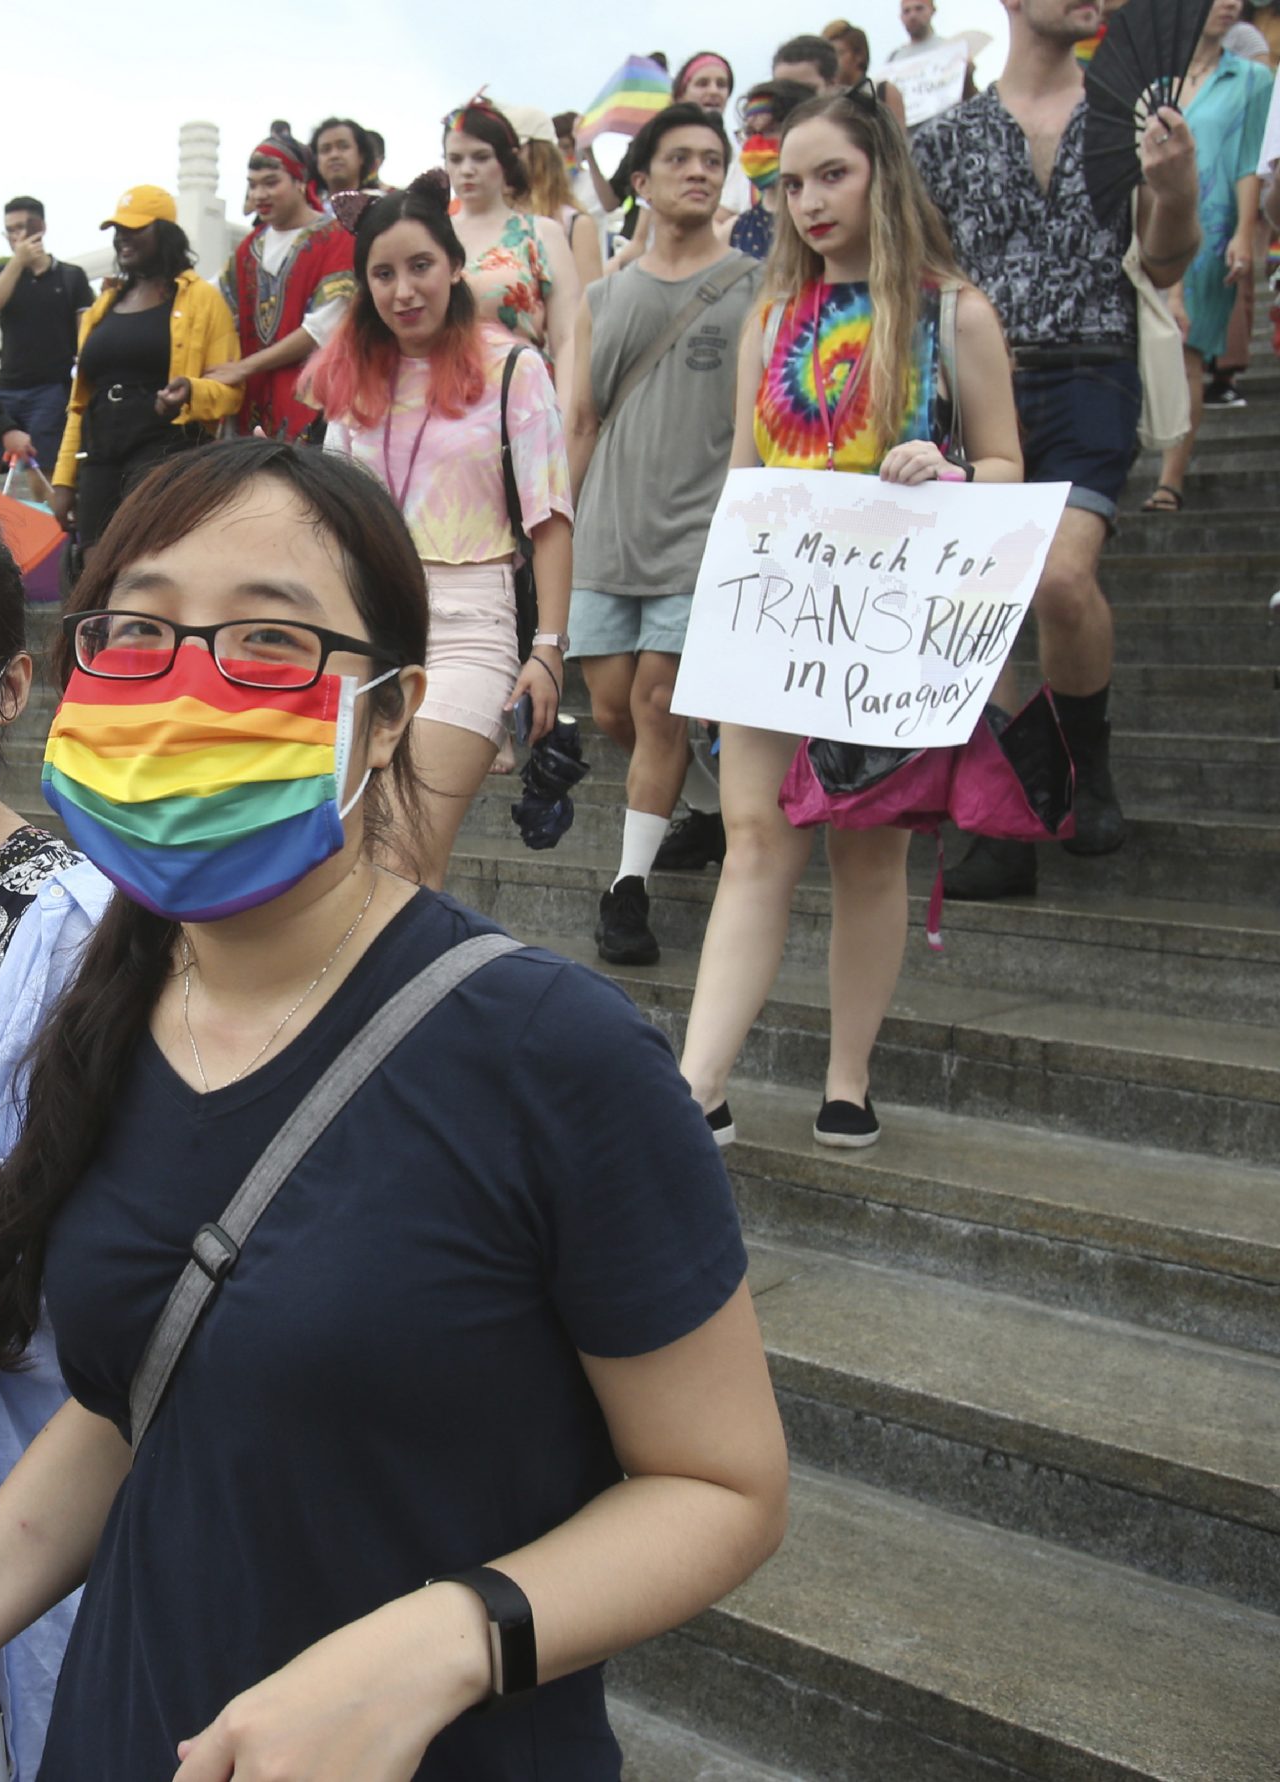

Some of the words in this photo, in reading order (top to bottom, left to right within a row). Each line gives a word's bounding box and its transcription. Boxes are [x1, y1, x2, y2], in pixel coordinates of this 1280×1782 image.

[752, 532, 771, 555] I
[794, 531, 910, 572] March
[935, 538, 997, 577] For
[717, 572, 913, 654] TRANS
[783, 648, 826, 698] in
[844, 662, 983, 738] Paraguay
